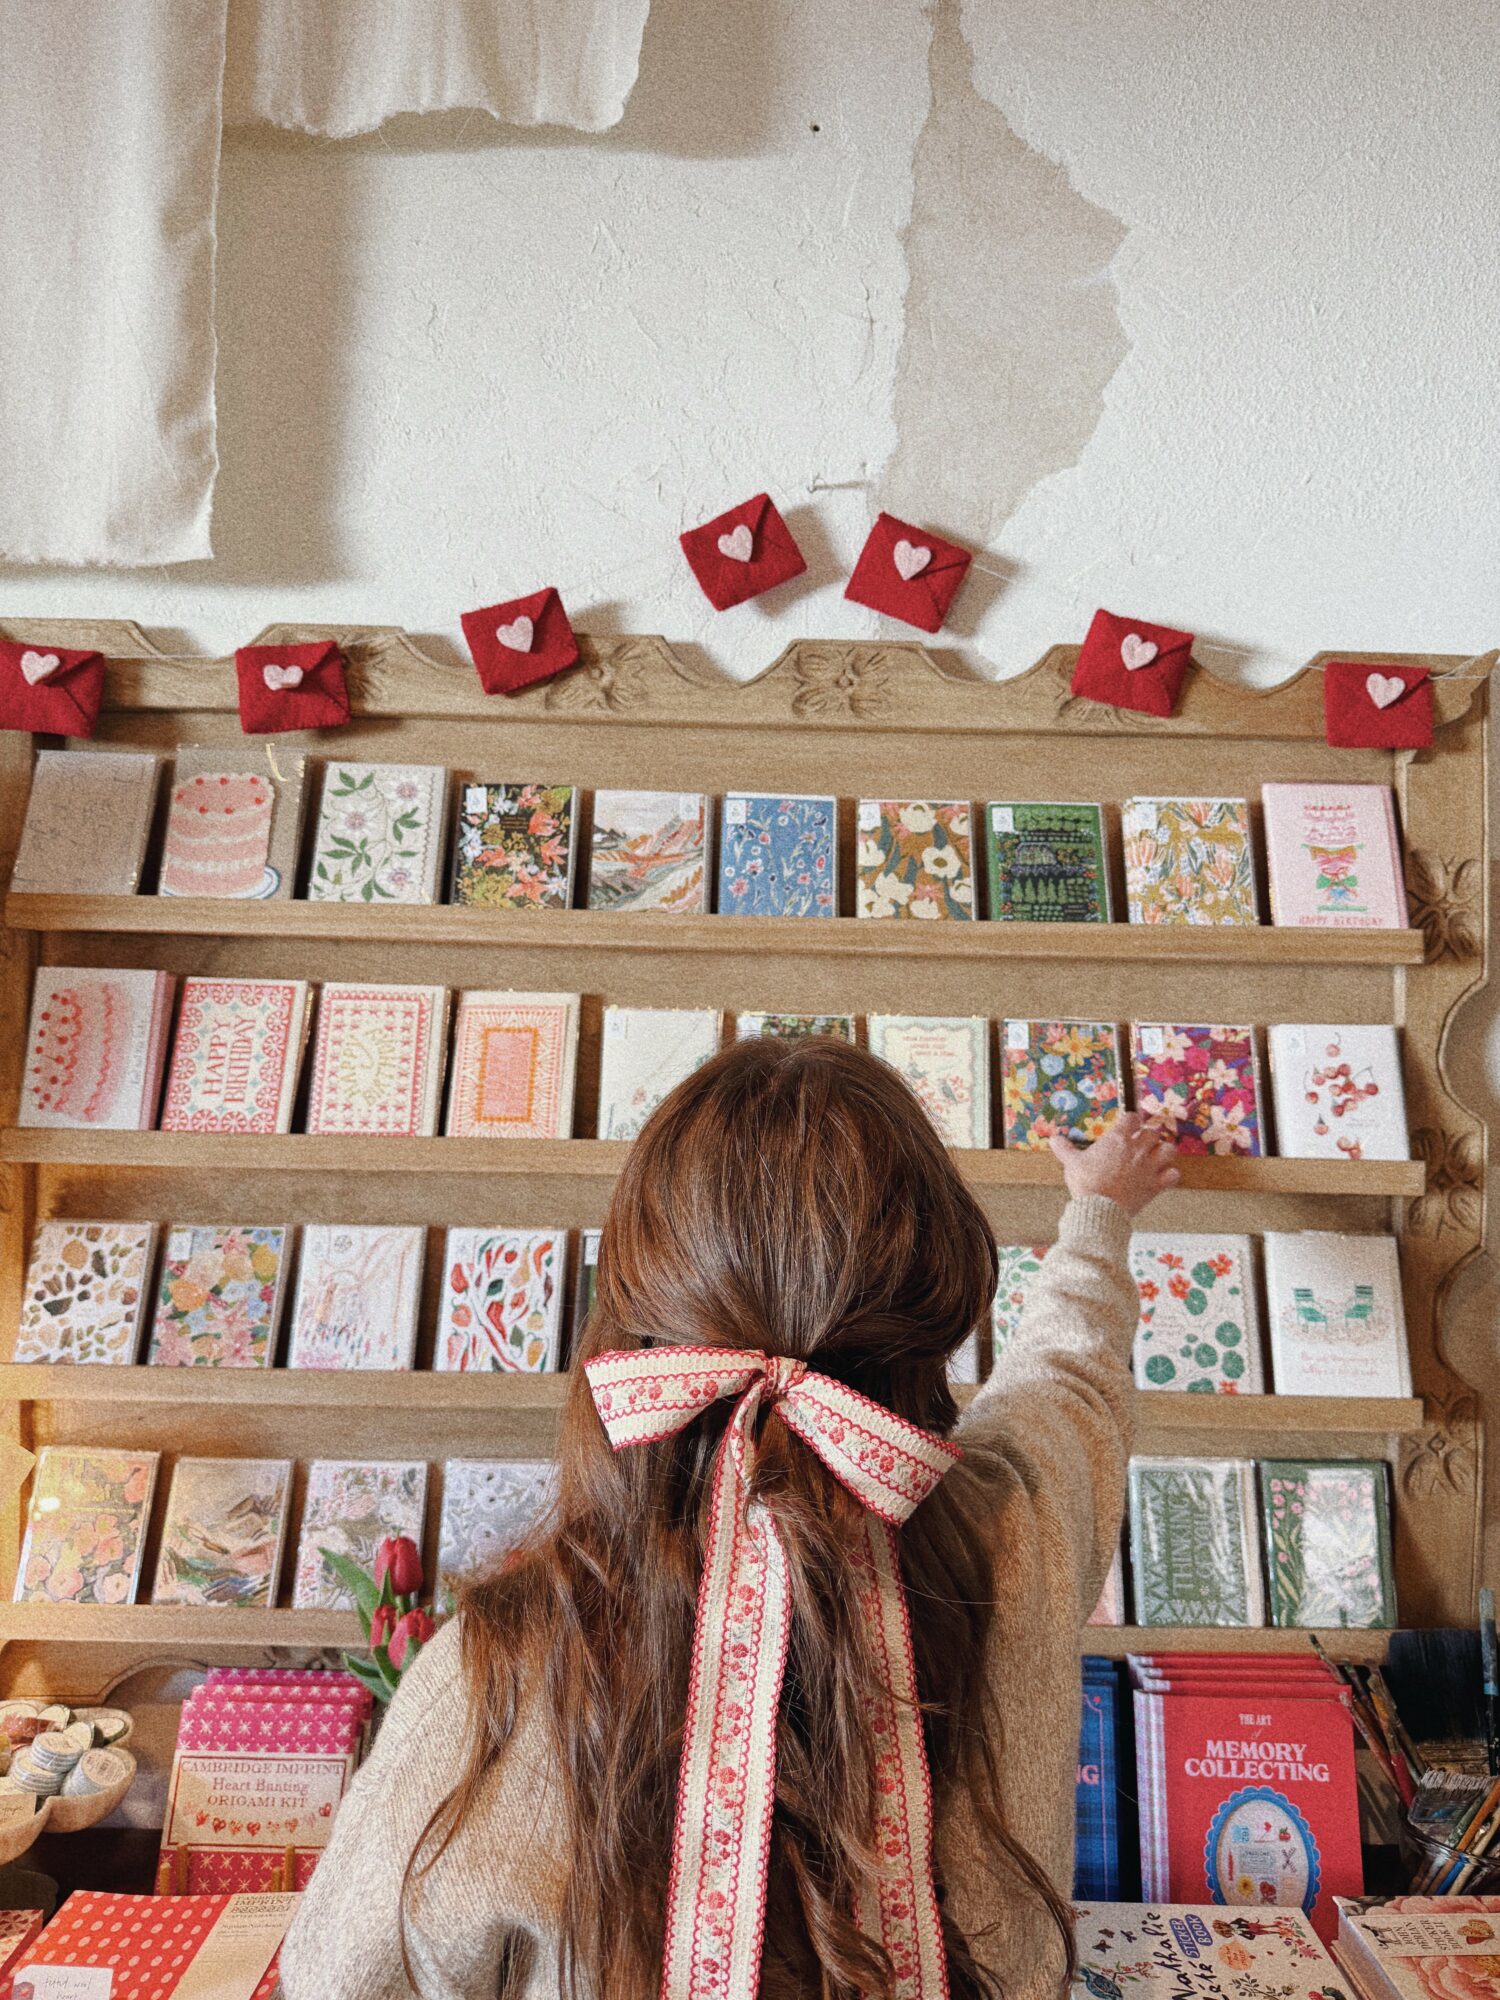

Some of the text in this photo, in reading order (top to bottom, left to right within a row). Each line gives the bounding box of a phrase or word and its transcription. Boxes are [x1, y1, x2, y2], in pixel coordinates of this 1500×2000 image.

[202, 1015, 231, 1095] HAPPY
[224, 1014, 257, 1103] BIRTHDAY
[1167, 1497, 1194, 1595] THINKING
[1238, 1714, 1272, 1726] THE ART
[1205, 1740, 1307, 1762] MEMORY
[182, 1760, 344, 1776] CAMBRIDGE IMPRINT
[1184, 1758, 1330, 1782] COLLECTING
[212, 1777, 312, 1796] Heart Bunting
[207, 1795, 309, 1809] ORIGAMI KIT
[1188, 1915, 1213, 1945] BOOK
[1392, 1926, 1416, 1946] JOHN
[1404, 1921, 1432, 1950] DERIAN
[1420, 1919, 1451, 1951] STICKER
[1440, 1930, 1464, 1950] BOOK
[1142, 1911, 1198, 2000] Nathalie
